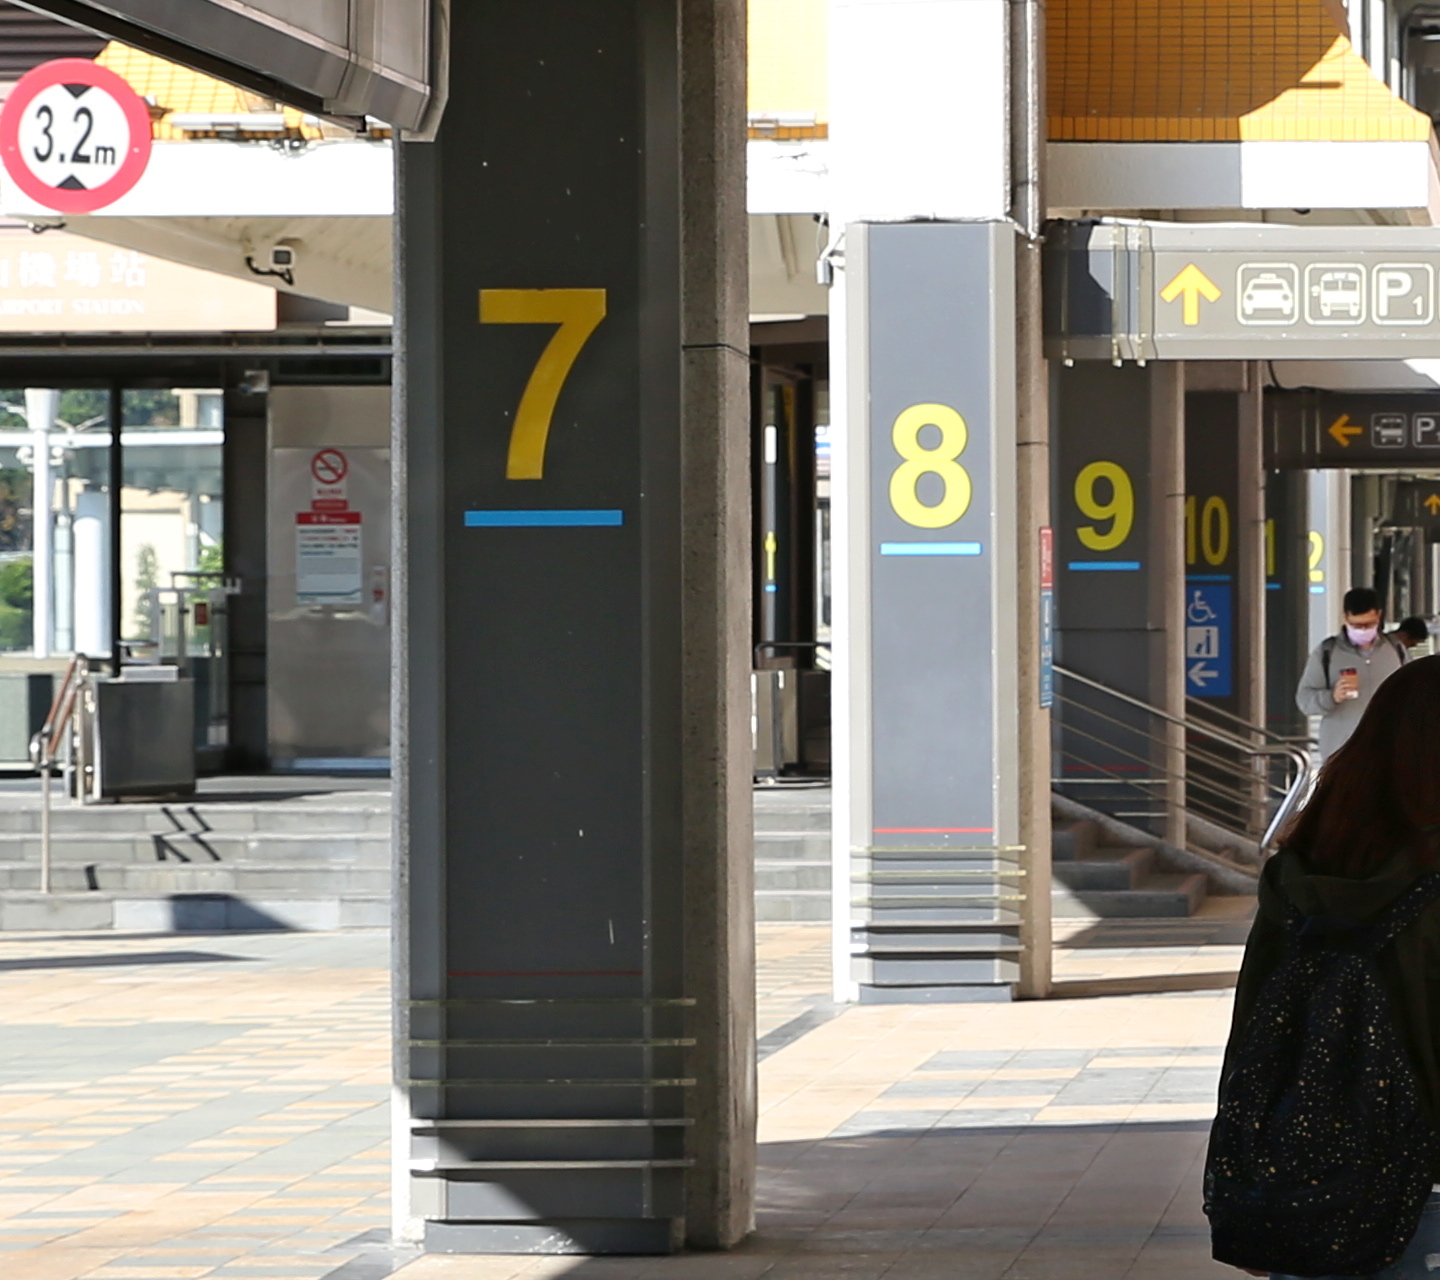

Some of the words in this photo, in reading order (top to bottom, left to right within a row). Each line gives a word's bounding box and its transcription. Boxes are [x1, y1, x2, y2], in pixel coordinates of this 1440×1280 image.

[33, 104, 116, 165] 3.2m
[1377, 271, 1425, 317] P1
[477, 287, 608, 481] 7
[889, 402, 973, 529] 8
[1073, 460, 1135, 552] 9
[1184, 495, 1230, 566] 10
